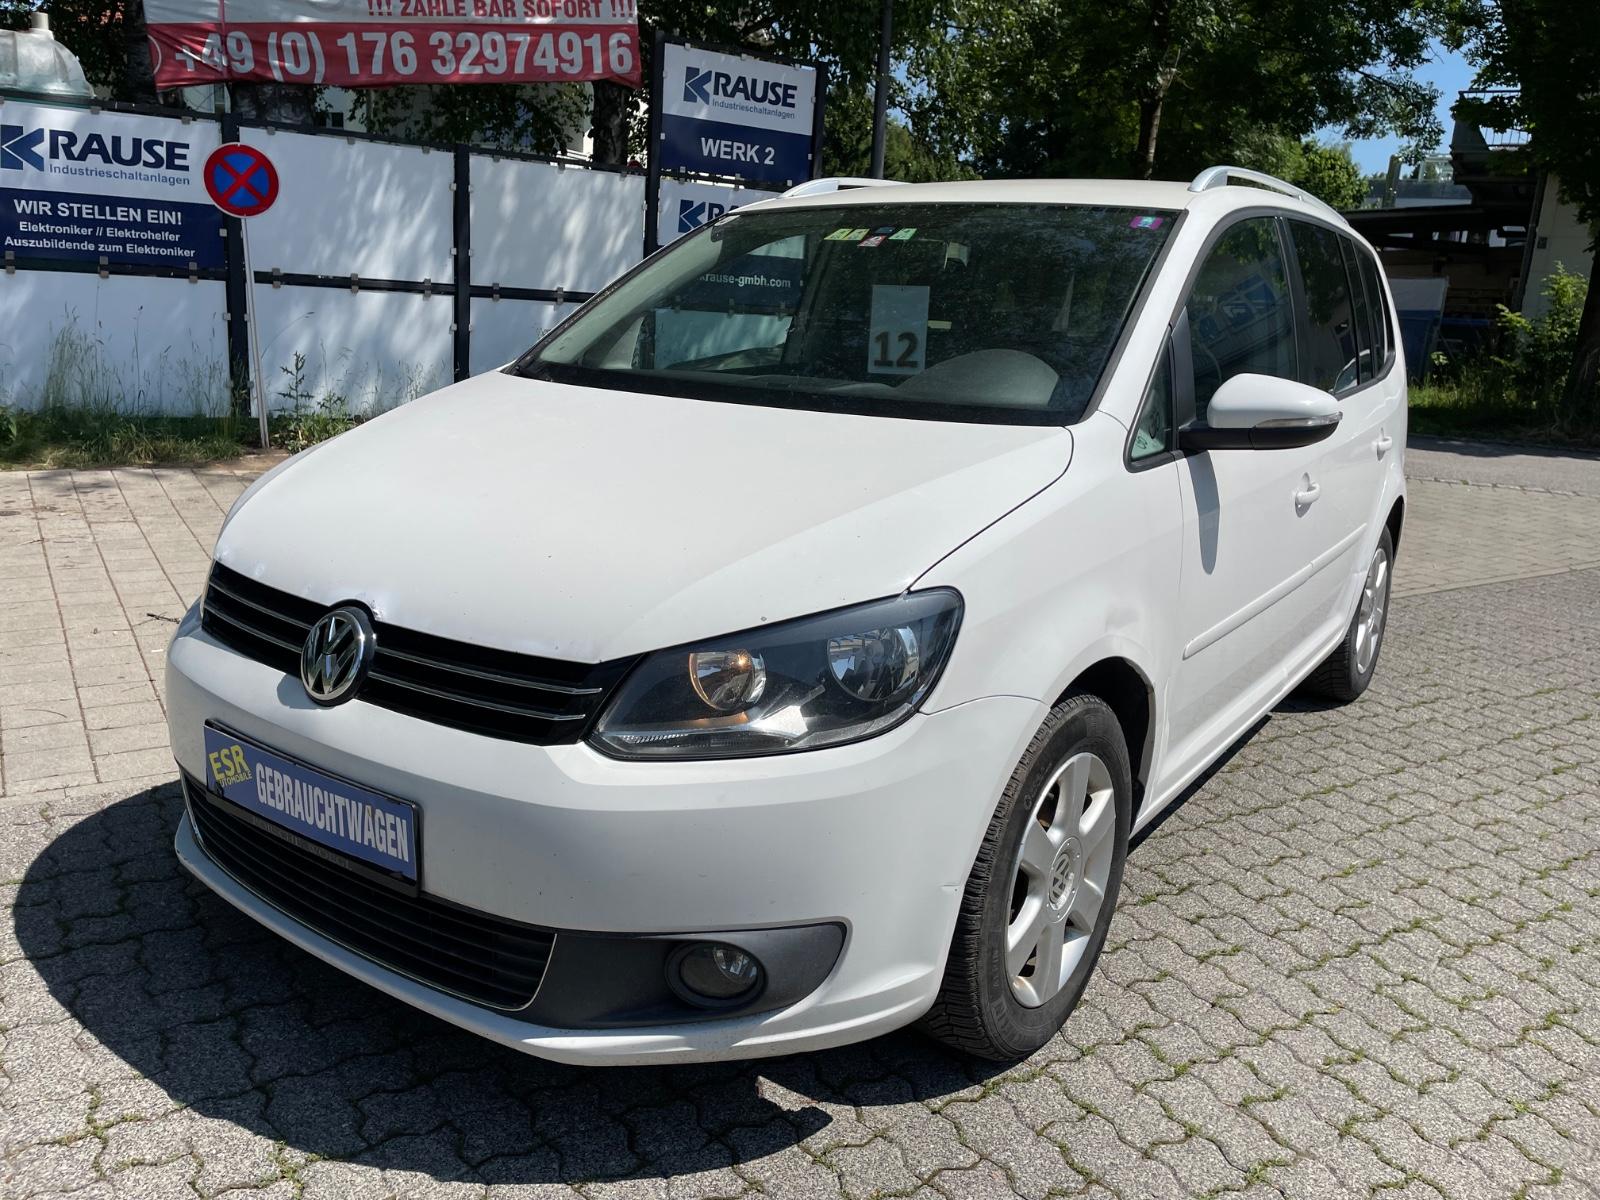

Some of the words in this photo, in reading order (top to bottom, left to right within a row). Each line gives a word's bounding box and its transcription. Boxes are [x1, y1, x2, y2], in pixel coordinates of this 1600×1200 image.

[400, 0, 467, 16] ZAHLE
[473, 0, 516, 17] BAR
[523, 0, 602, 18] SOFORT
[175, 31, 255, 74] +49
[268, 31, 325, 83] (0)
[337, 31, 417, 75] 176
[429, 31, 633, 75] 32974916
[682, 66, 798, 109] KRAUSE
[712, 99, 796, 120] Industrieschaltanlagen
[0, 124, 191, 172] KRAUSE
[701, 137, 760, 165] WERK
[763, 147, 775, 166] 2
[50, 164, 191, 187] Industrieschaltanlagen
[14, 199, 53, 216] WIR
[57, 203, 142, 223] STELLEN
[147, 209, 182, 226] EIN!
[678, 199, 738, 234] KR
[19, 221, 94, 236] Elektroniker
[106, 227, 181, 242] Elektrohelfer
[4, 236, 95, 251] Auszubildende
[98, 244, 123, 253] zum
[126, 243, 196, 258] Elektroniker
[873, 330, 919, 369] 12
[208, 744, 250, 781] ESR
[217, 769, 253, 788] UTOMOBILE
[255, 762, 410, 863] GEBRAUCHTWAGEN
